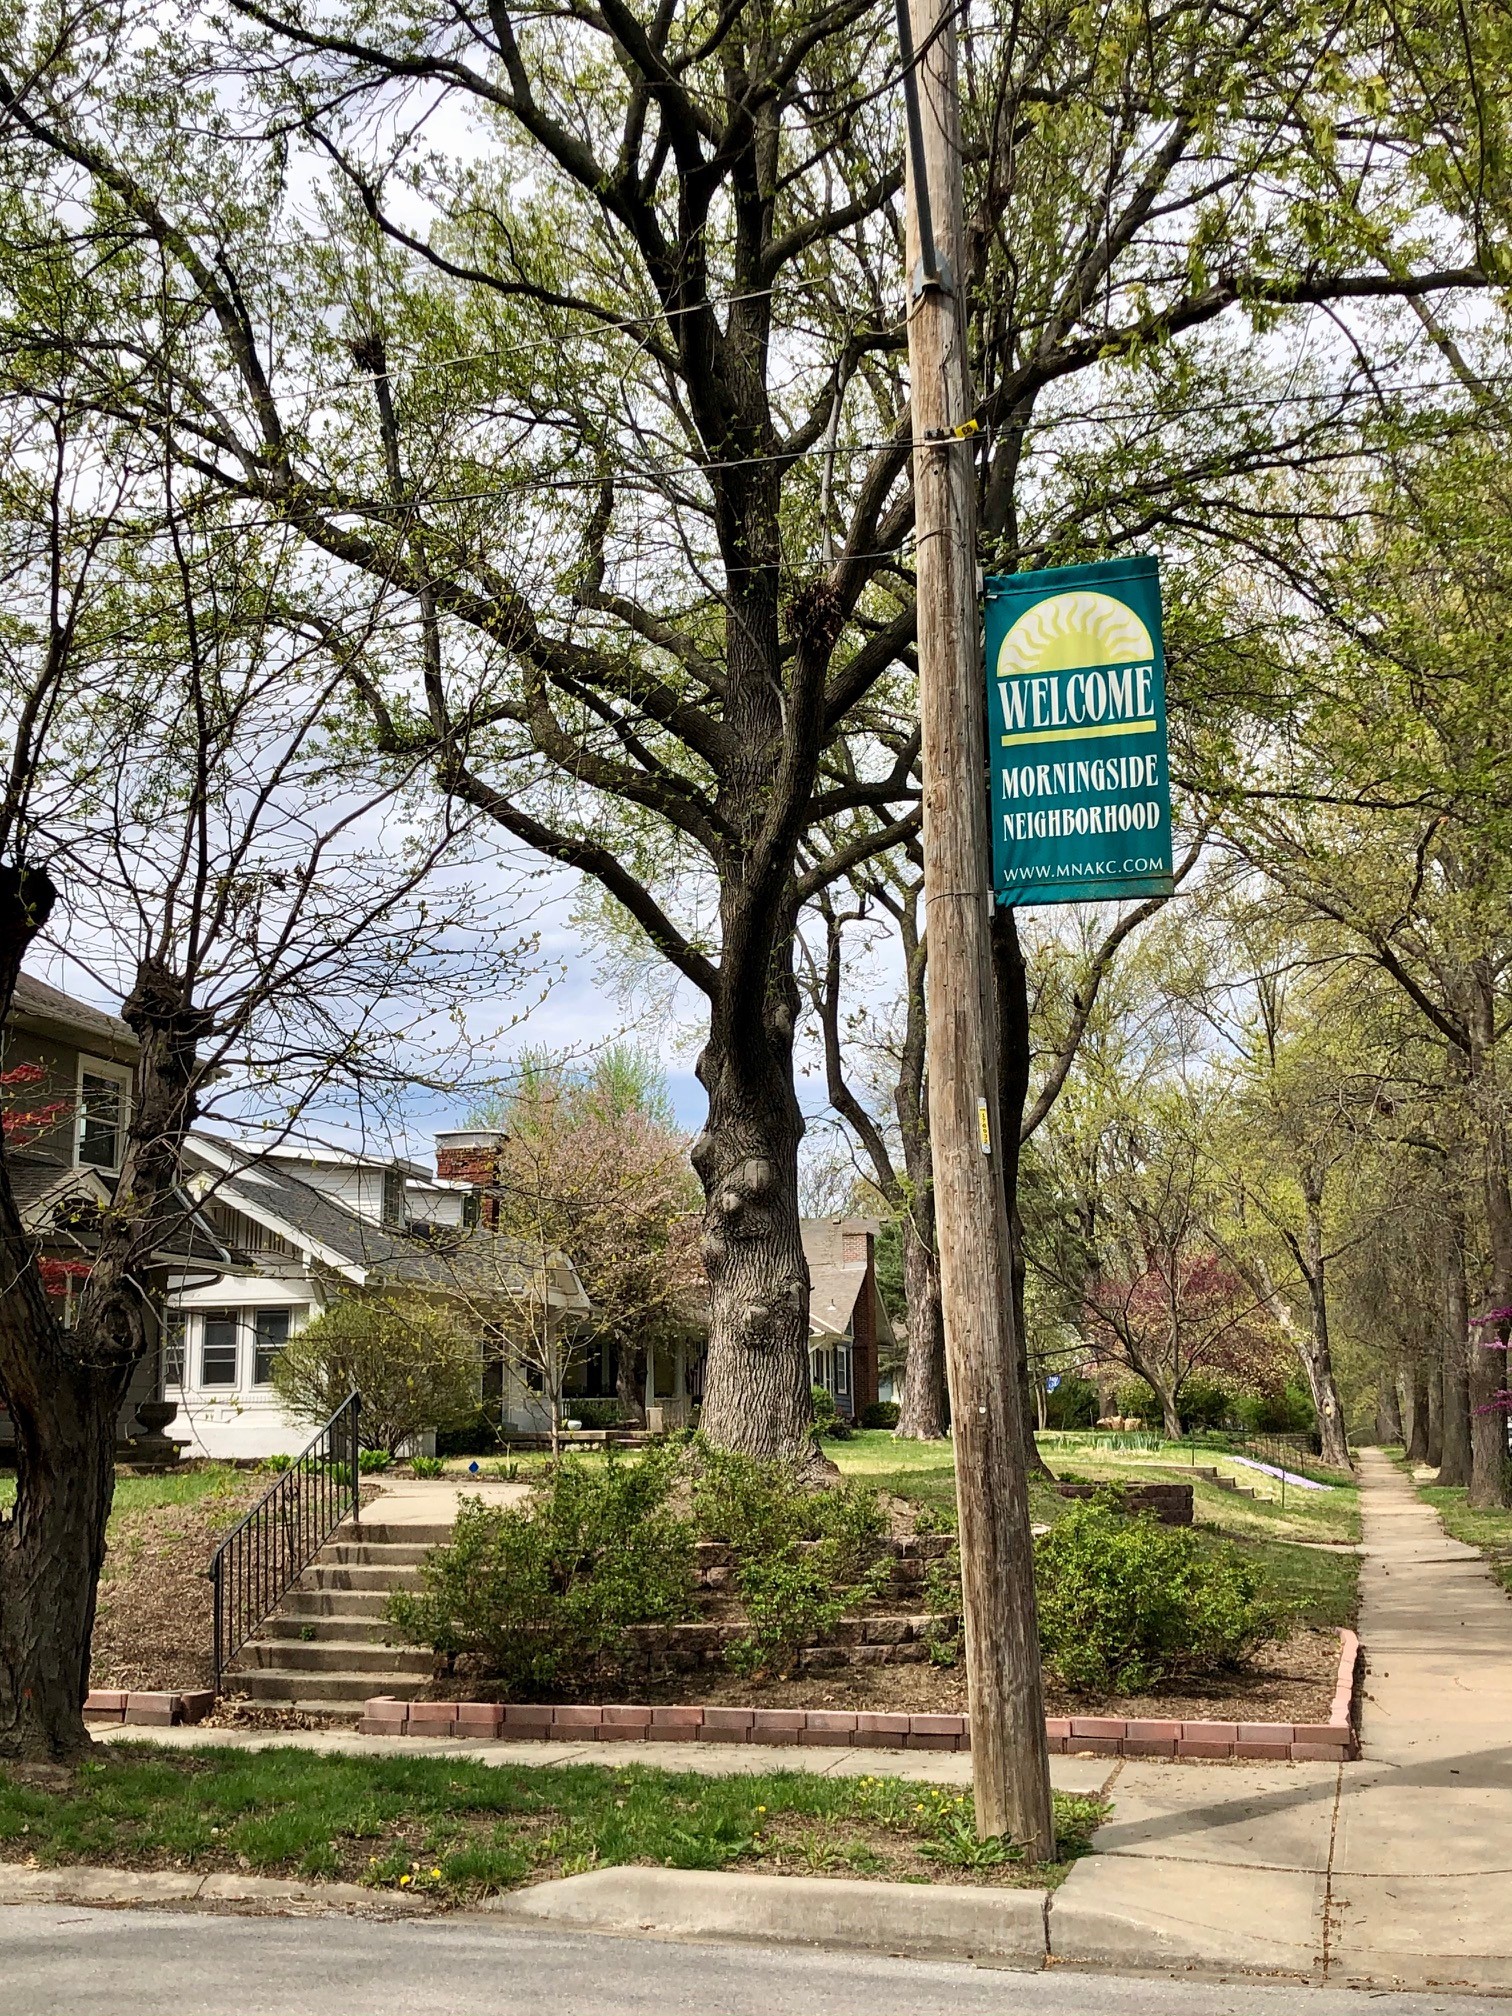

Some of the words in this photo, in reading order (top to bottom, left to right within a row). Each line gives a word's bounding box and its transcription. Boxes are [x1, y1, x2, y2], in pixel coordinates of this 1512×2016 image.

[997, 666, 1155, 730] WELCOME
[1001, 754, 1159, 800] MORNINGSIDE
[1003, 801, 1160, 842] NEIGHBORHOOD
[1003, 857, 1164, 882] WWW.MNAKC.COM
